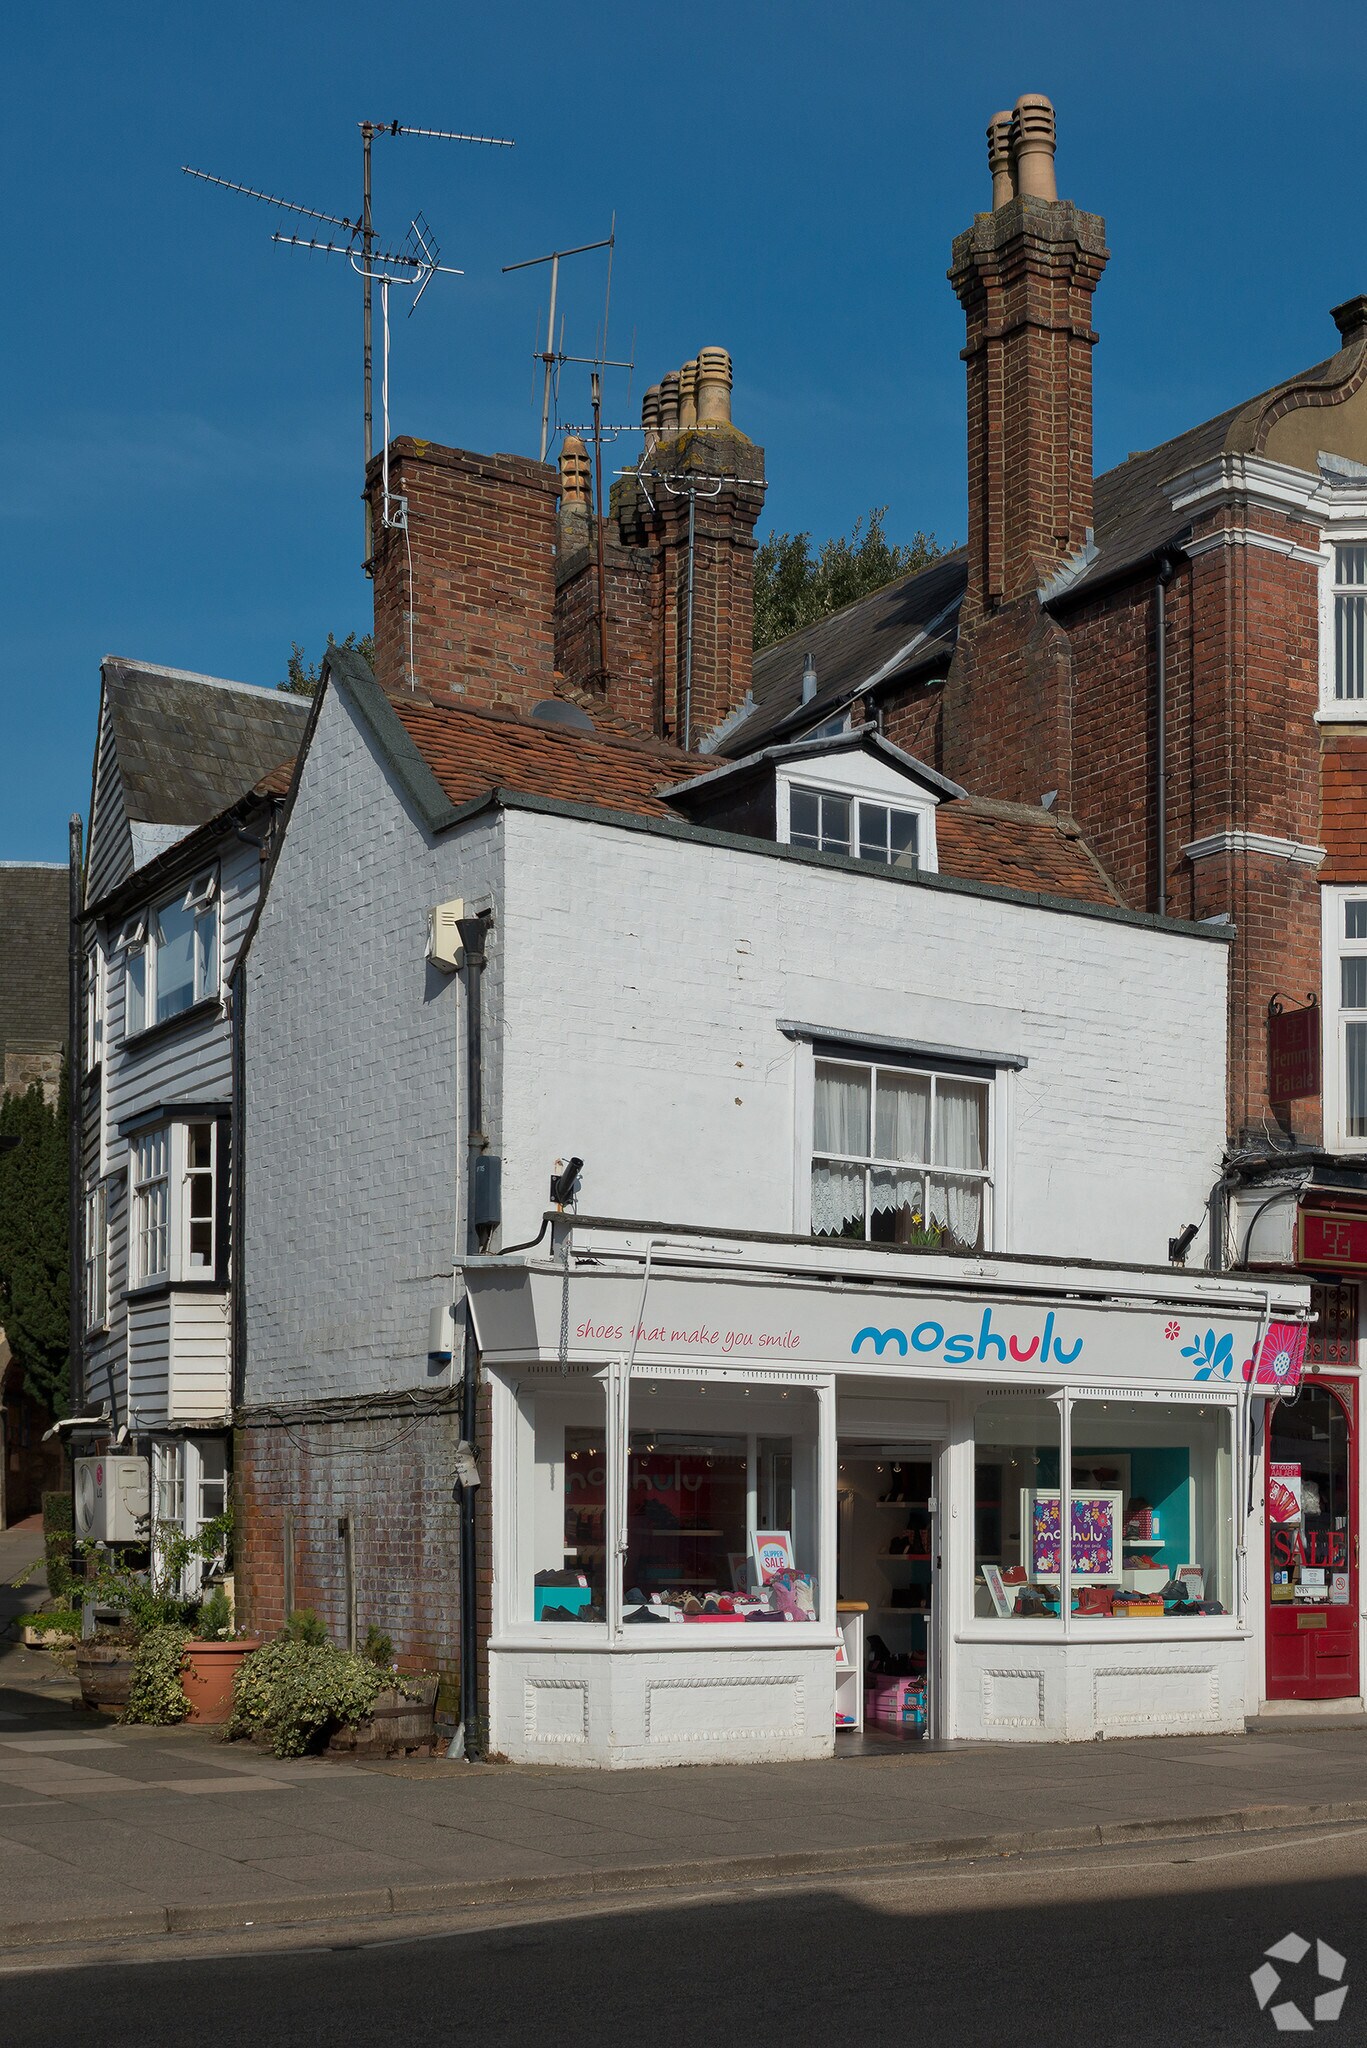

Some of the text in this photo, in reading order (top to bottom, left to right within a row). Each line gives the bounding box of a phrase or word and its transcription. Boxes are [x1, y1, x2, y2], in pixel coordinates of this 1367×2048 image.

[1275, 1068, 1314, 1094] Fatale
[576, 1318, 801, 1352] shoes that make you smile
[850, 1307, 1084, 1365] moshulu
[97, 1488, 103, 1498] LG
[764, 1557, 785, 1568] SALE
[1274, 1530, 1345, 1567] SALE
